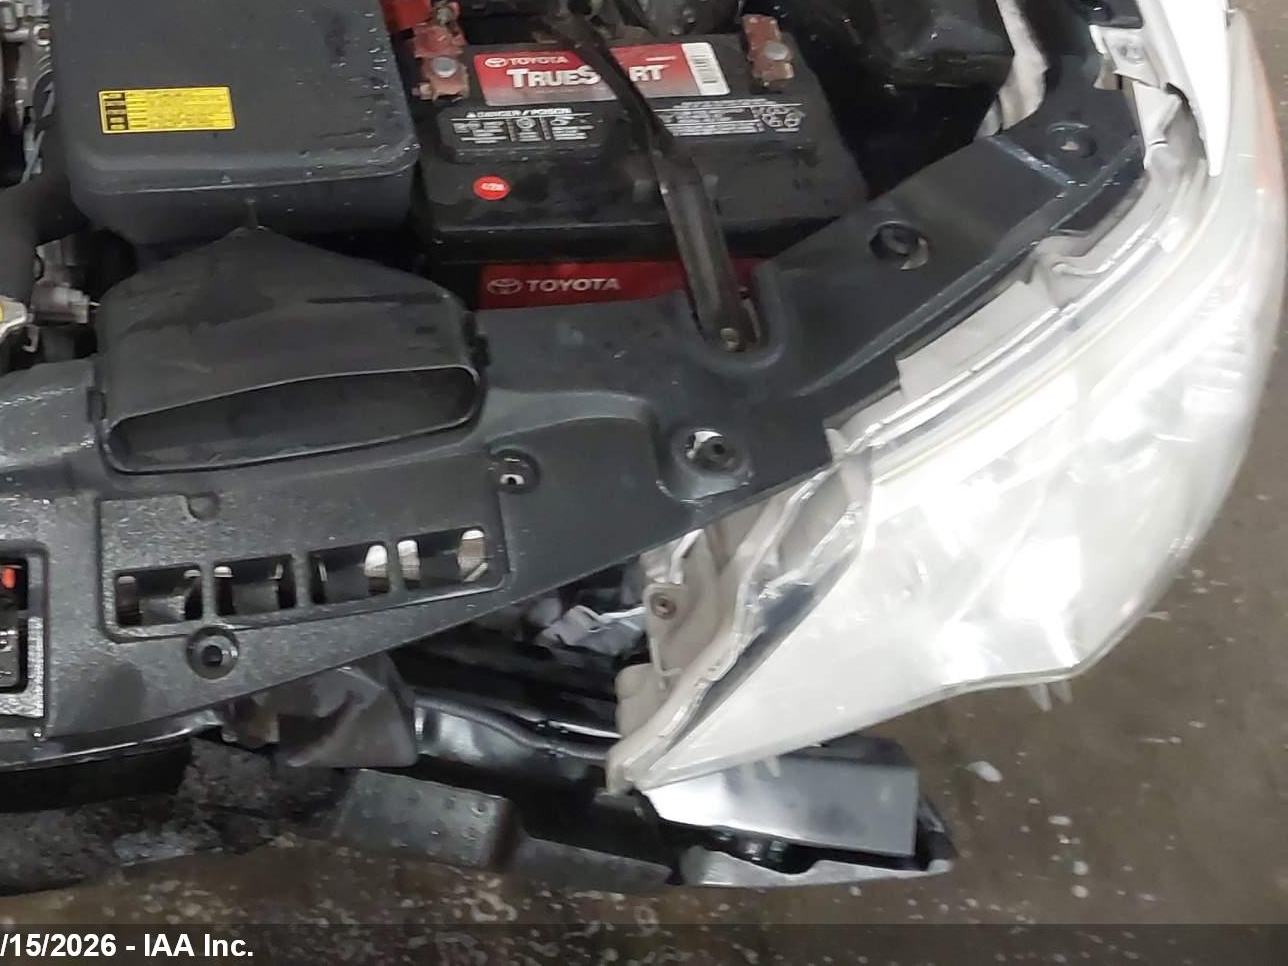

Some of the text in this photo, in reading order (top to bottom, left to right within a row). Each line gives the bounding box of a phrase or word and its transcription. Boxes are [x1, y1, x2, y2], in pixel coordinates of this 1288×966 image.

[507, 56, 569, 66] TOYOTA
[507, 65, 671, 89] TRUESRT
[526, 278, 621, 292] TOYOTA
